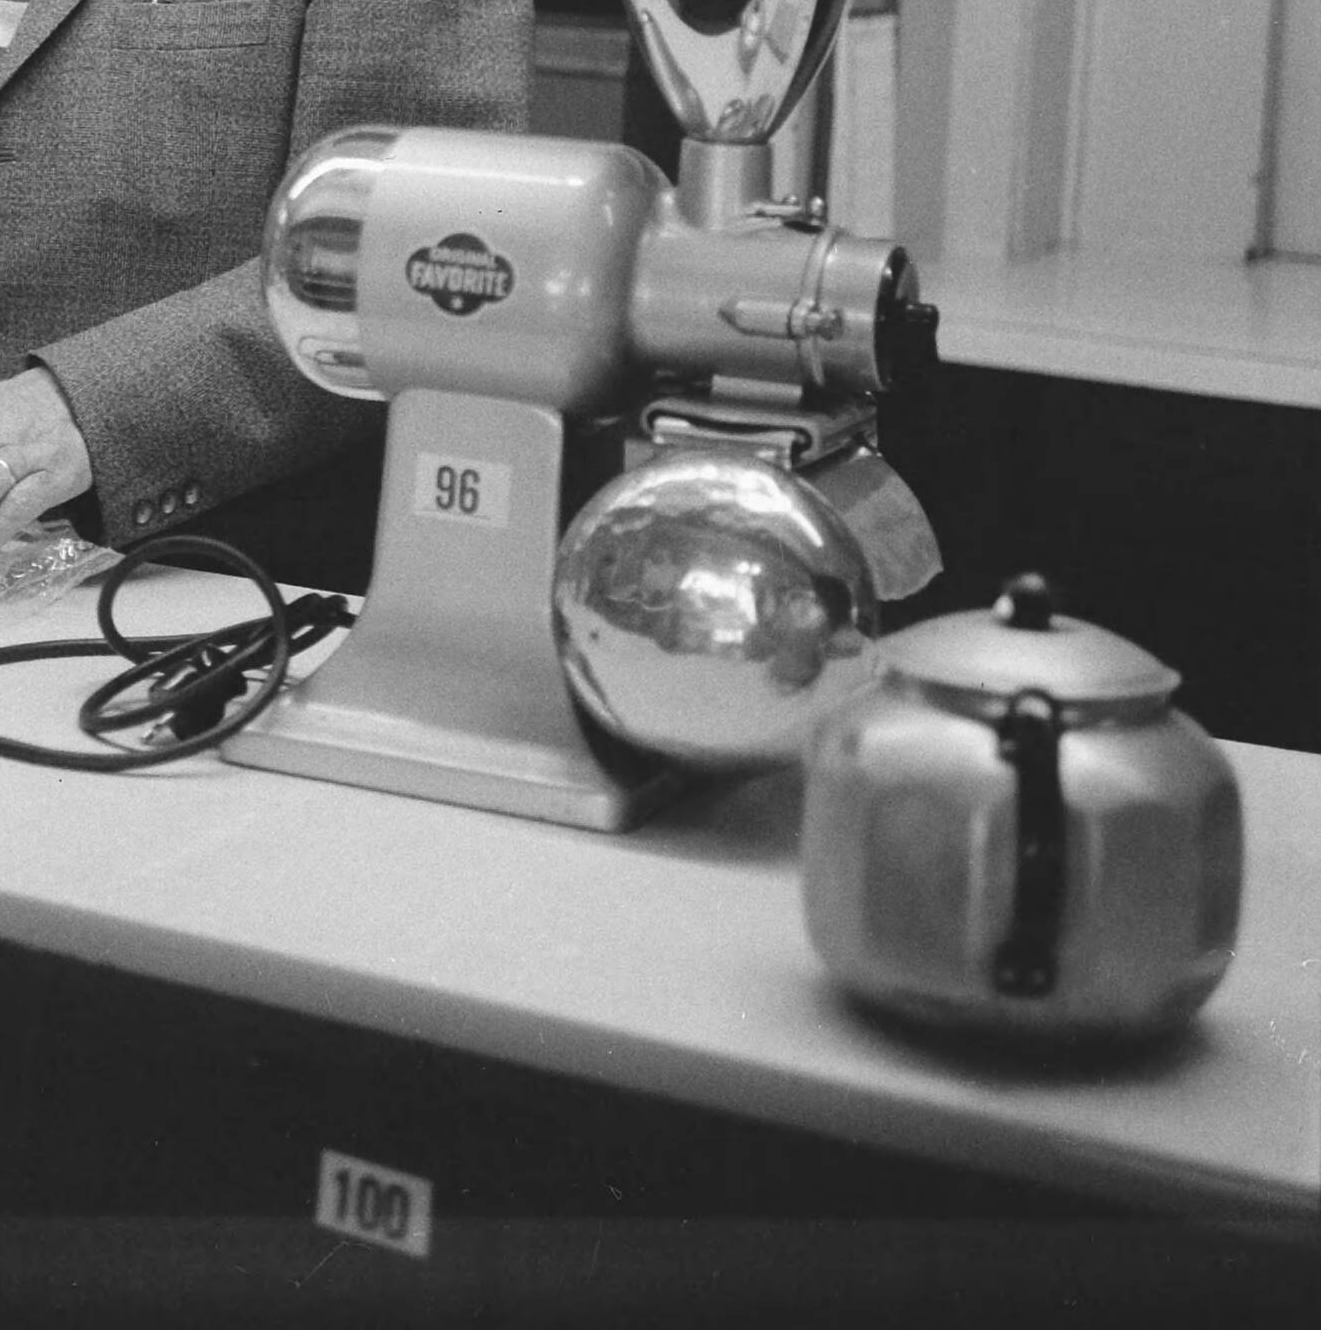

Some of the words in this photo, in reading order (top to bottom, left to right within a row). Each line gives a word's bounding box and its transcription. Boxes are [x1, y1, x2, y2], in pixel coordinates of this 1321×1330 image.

[410, 261, 508, 297] FAVORITE
[436, 465, 481, 514] 96
[334, 1169, 411, 1240] 100
